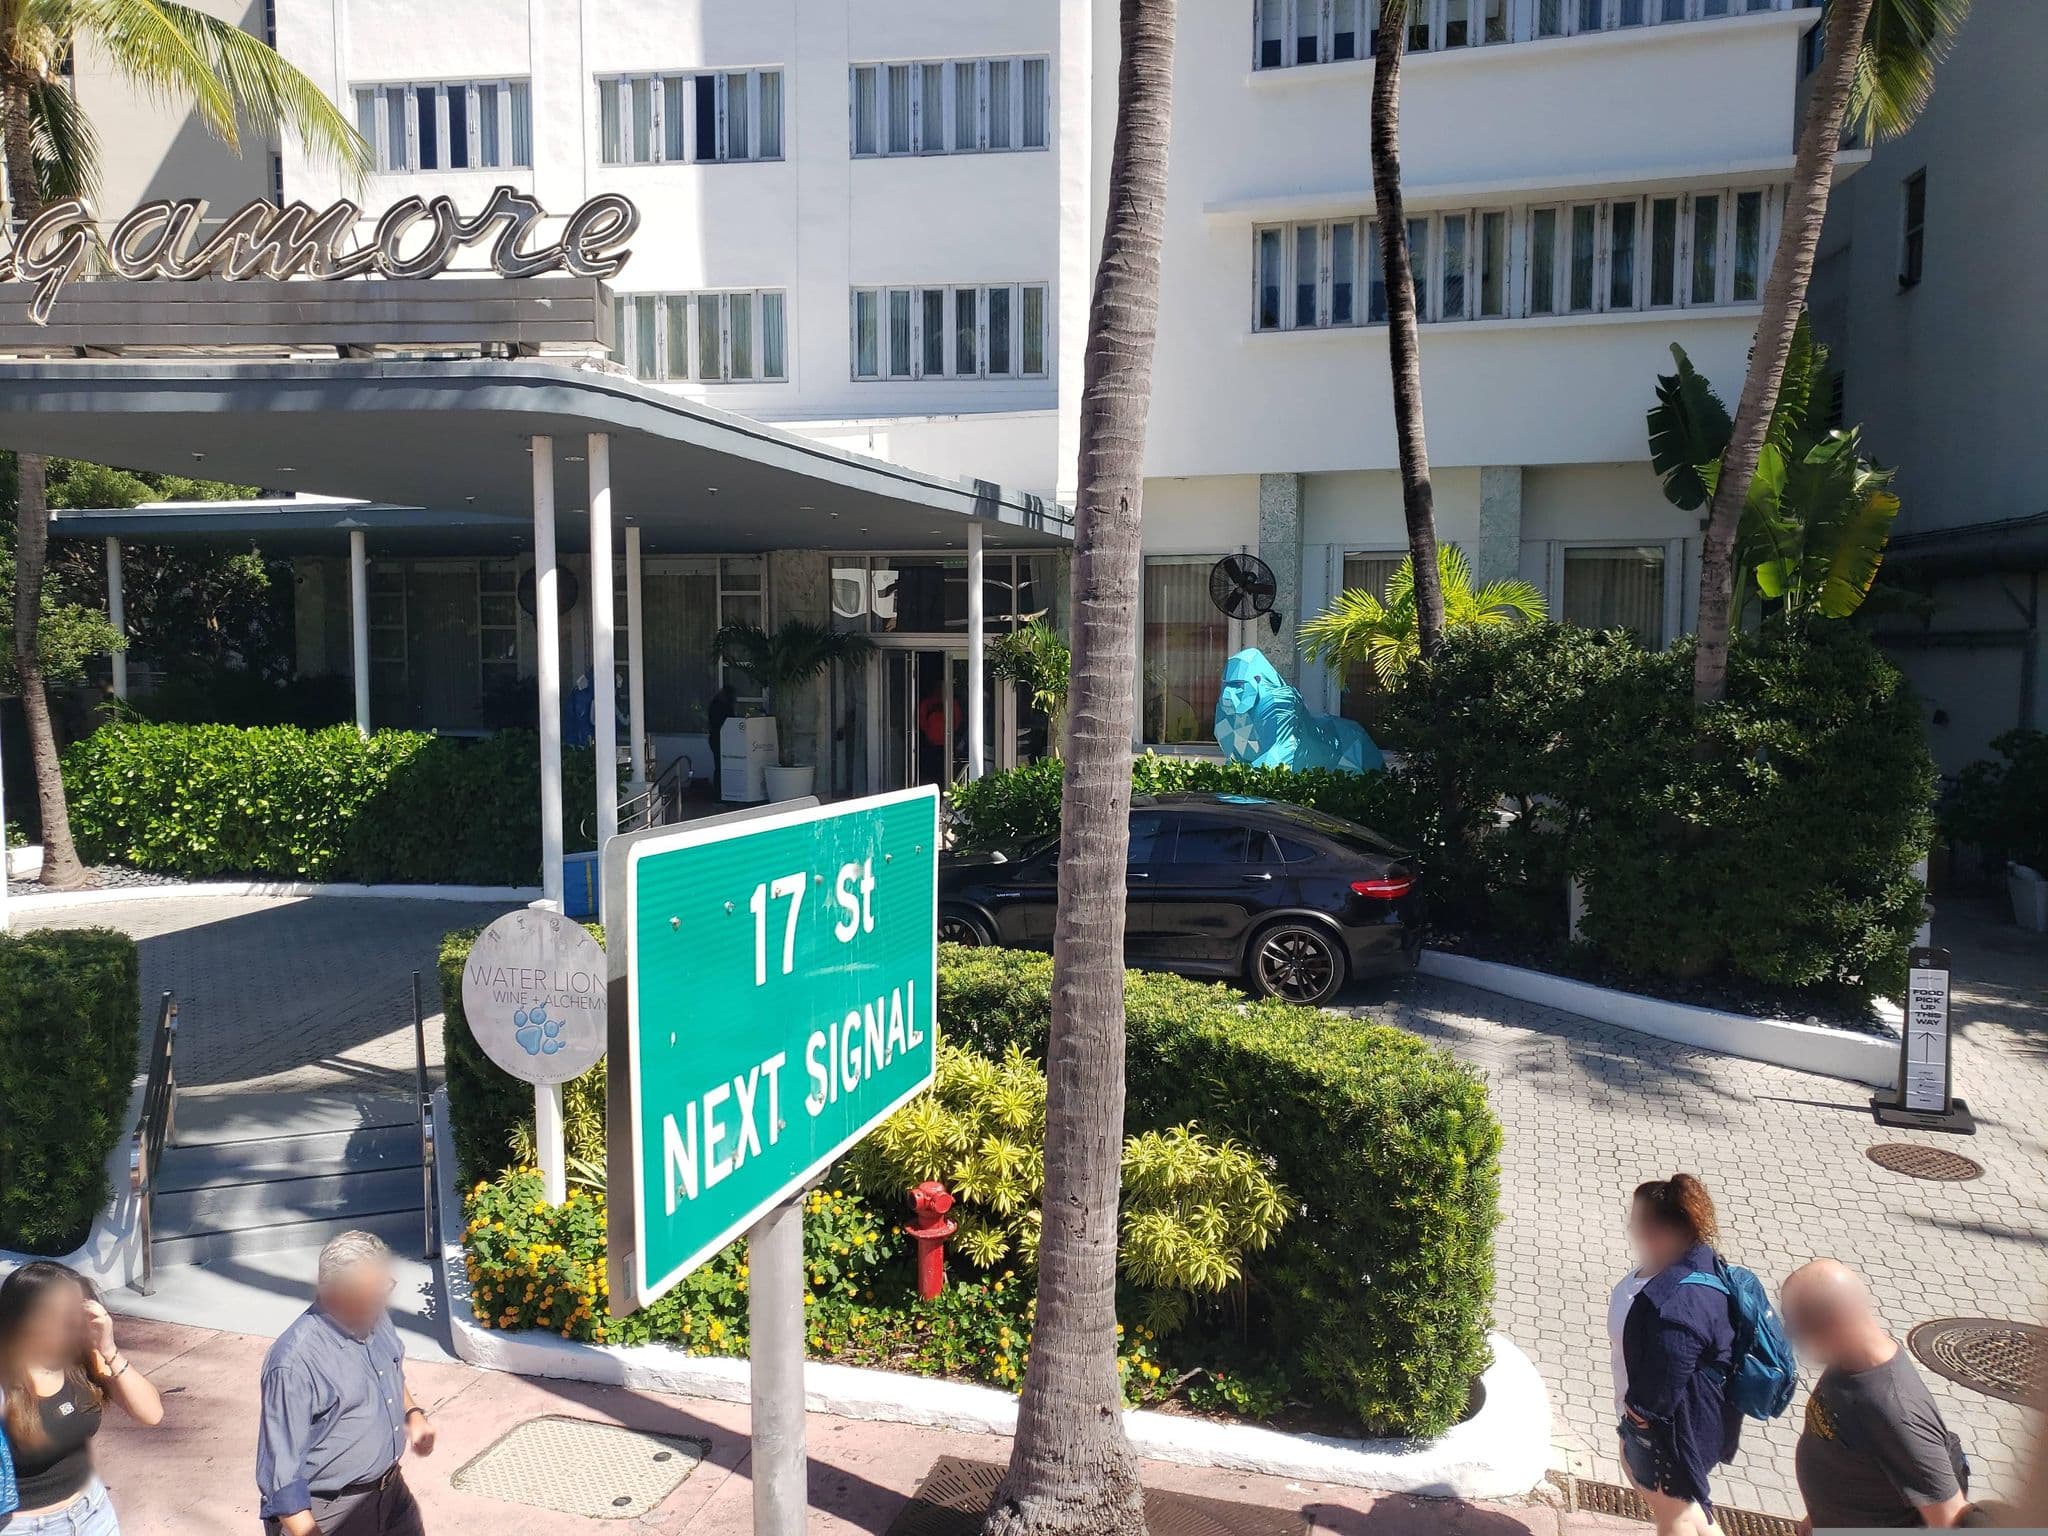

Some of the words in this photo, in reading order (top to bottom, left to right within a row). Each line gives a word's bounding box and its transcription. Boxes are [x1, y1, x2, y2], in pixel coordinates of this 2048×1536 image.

[0, 186, 641, 327] gamore
[470, 965, 547, 991] WATER
[554, 971, 607, 993] LION
[750, 871, 807, 987] 17
[834, 857, 875, 943] St
[493, 990, 528, 1004] WINE
[545, 994, 607, 1010] ALCHEMY
[663, 1050, 786, 1217] NEXT
[804, 979, 924, 1117] SIGNAL
